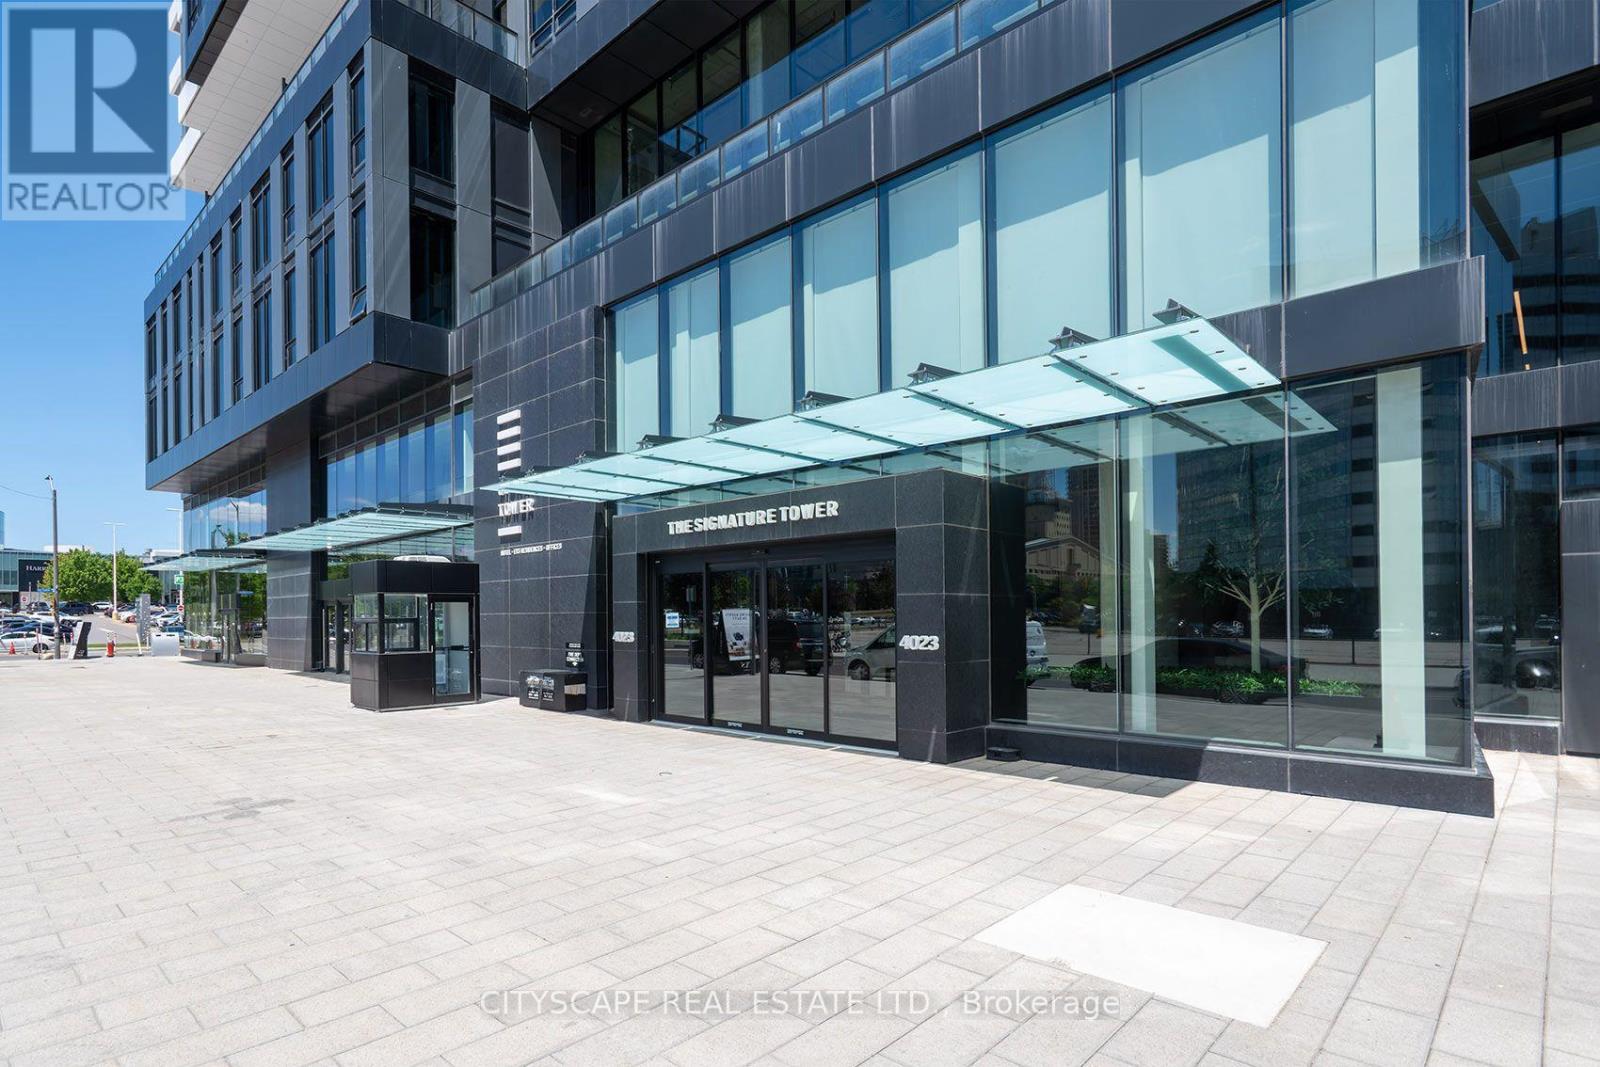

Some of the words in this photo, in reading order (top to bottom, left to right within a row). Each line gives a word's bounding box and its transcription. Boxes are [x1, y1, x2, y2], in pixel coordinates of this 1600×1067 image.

[667, 520, 693, 534] THE
[694, 508, 777, 532] SIGNATURE
[779, 500, 839, 522] TOWER
[899, 635, 940, 650] 4023
